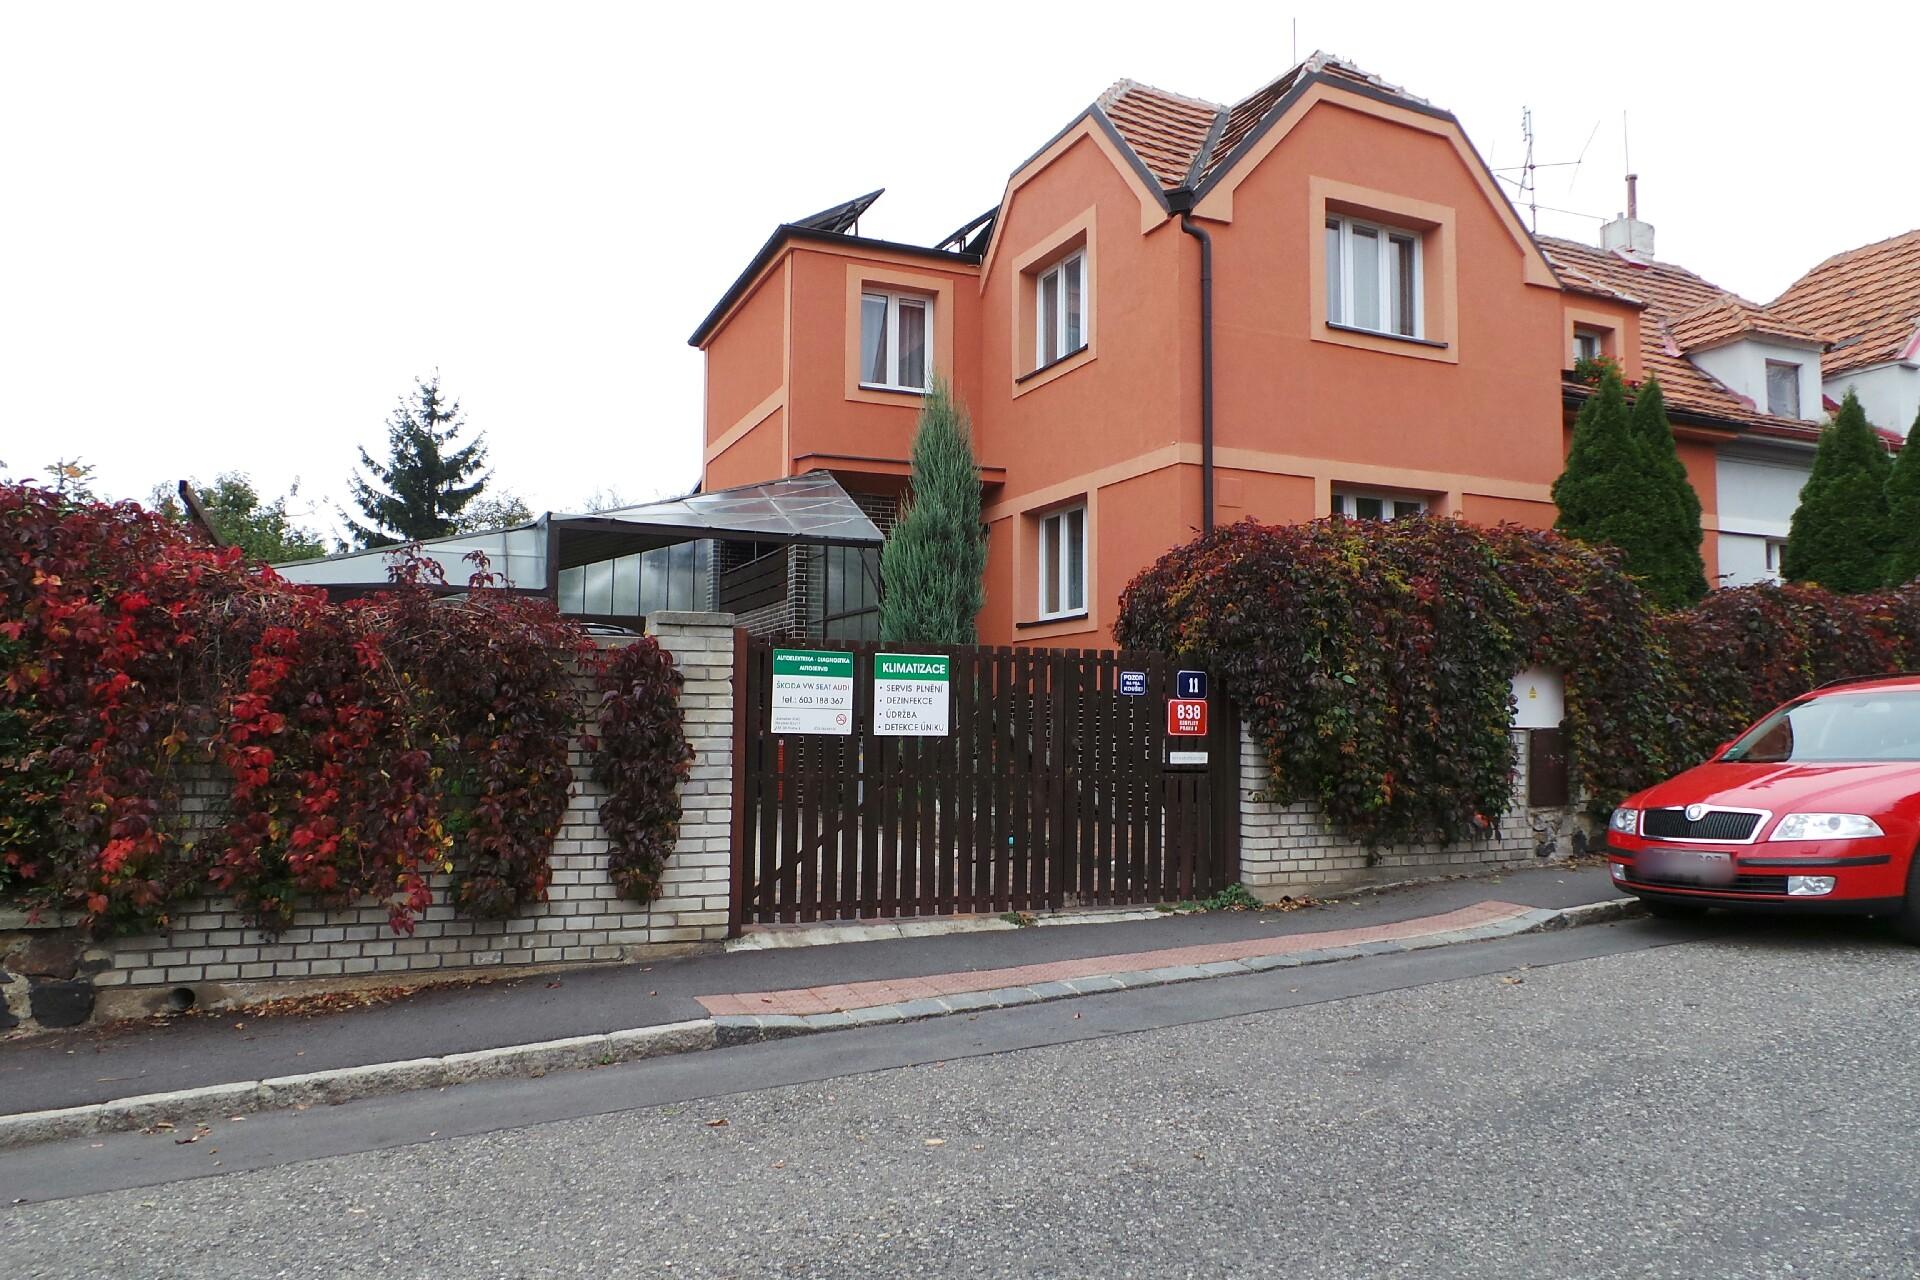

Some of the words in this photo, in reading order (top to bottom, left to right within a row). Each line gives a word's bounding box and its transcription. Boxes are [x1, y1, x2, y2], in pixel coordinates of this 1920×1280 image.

[882, 662, 946, 674] KLIMATIZACE
[776, 680, 800, 689] ŠKODA
[802, 682, 814, 690] VW
[815, 683, 831, 691] SEAT
[886, 684, 913, 692] SERVIS
[1188, 677, 1199, 693] 11
[830, 697, 844, 705] 367
[886, 696, 933, 705] DEZINFEKCE
[885, 708, 918, 719] ÚDRŽBA
[1177, 704, 1201, 720] 838
[884, 723, 919, 731] DETEKCE
